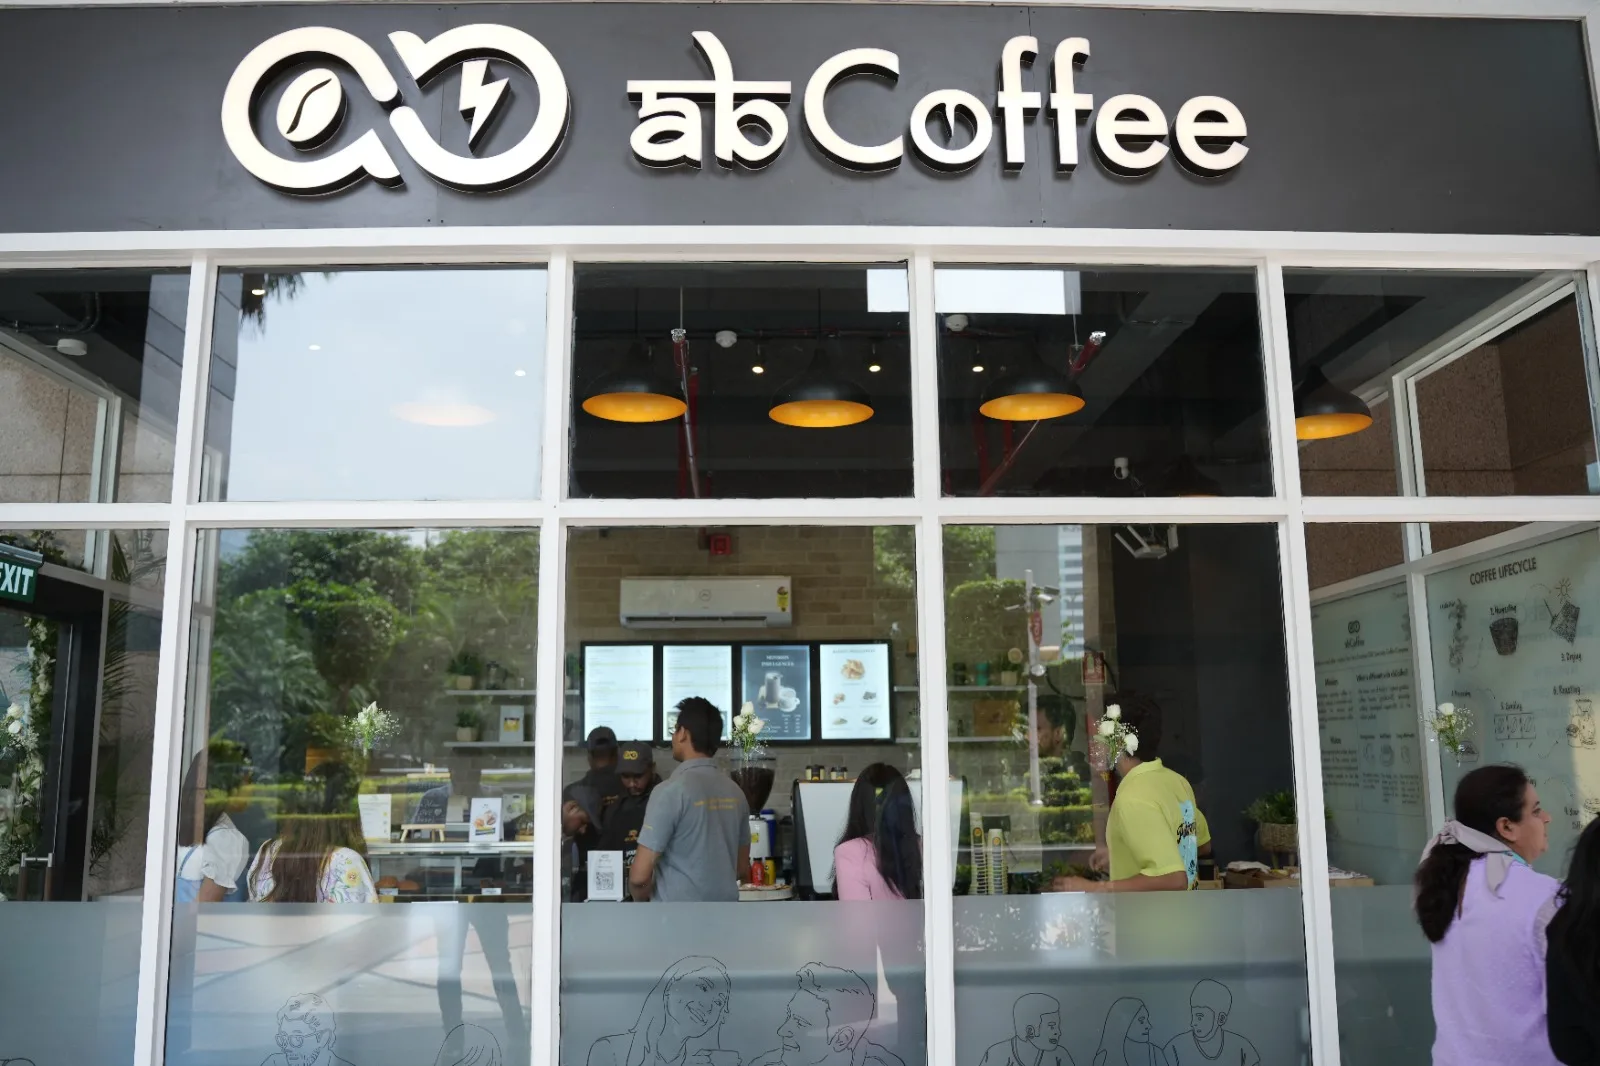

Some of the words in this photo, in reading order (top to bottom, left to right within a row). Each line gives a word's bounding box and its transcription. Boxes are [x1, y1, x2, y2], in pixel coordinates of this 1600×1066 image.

[0, 561, 34, 596] XIT
[1469, 567, 1497, 585] COFFEE
[1498, 557, 1537, 579] LIFECYCLE
